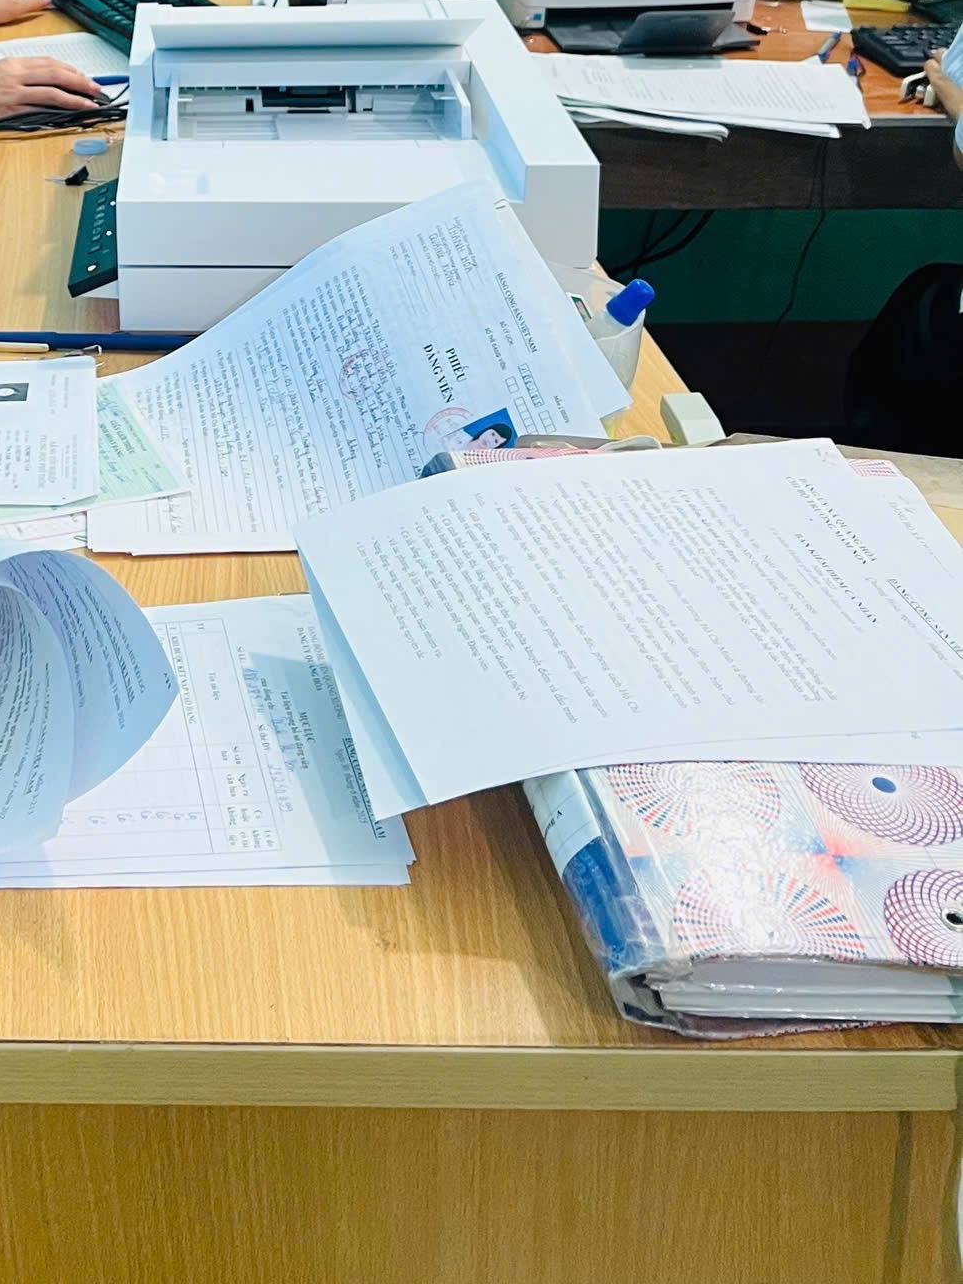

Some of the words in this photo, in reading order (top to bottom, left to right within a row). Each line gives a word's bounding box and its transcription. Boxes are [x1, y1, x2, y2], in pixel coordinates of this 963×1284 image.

[525, 336, 538, 353] NAM
[423, 343, 445, 375] ĐẢNG
[435, 374, 455, 403] VIÊN
[446, 346, 469, 382] PHIẾU
